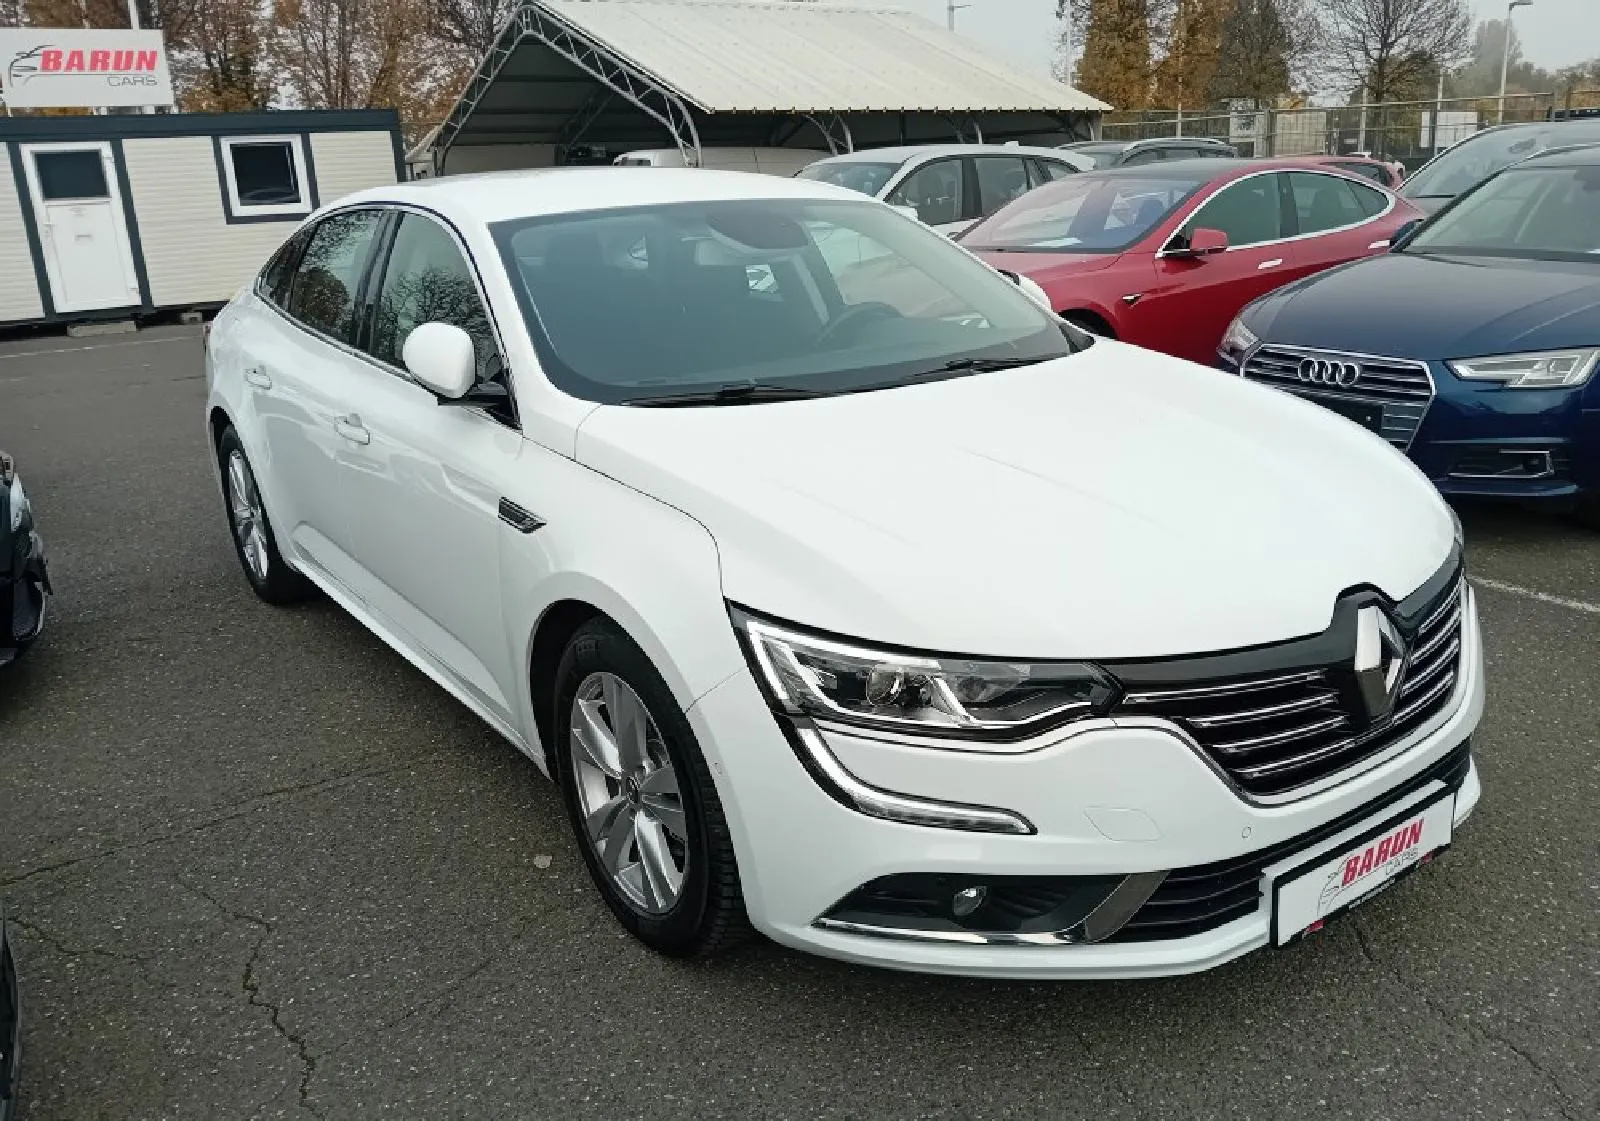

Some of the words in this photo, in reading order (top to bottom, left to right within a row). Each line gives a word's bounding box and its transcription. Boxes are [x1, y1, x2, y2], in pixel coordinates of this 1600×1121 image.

[41, 50, 158, 72] BARUN
[107, 76, 158, 87] CARS
[1342, 818, 1424, 886] BARUN
